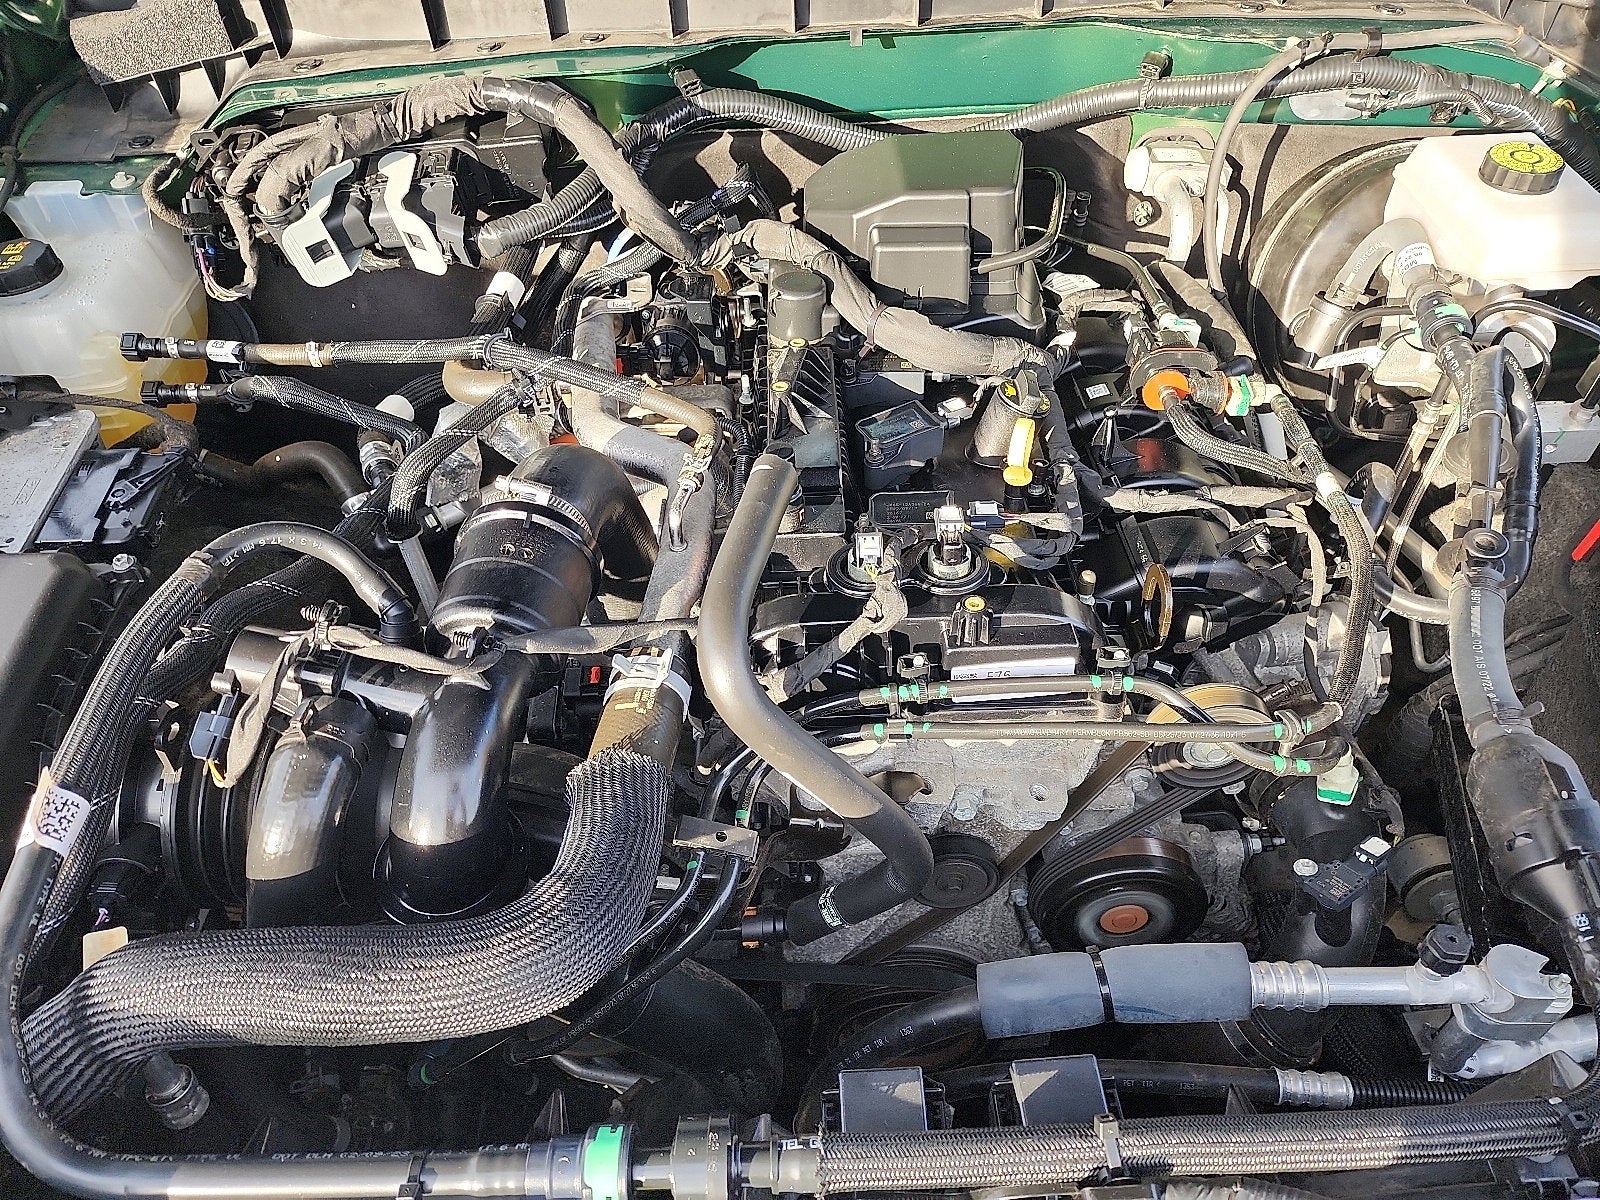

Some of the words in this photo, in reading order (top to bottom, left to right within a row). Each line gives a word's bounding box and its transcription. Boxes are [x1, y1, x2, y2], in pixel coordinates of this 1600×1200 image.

[258, 536, 283, 547] 17.6
[35, 877, 54, 906] TYPE
[12, 953, 25, 979] DOT
